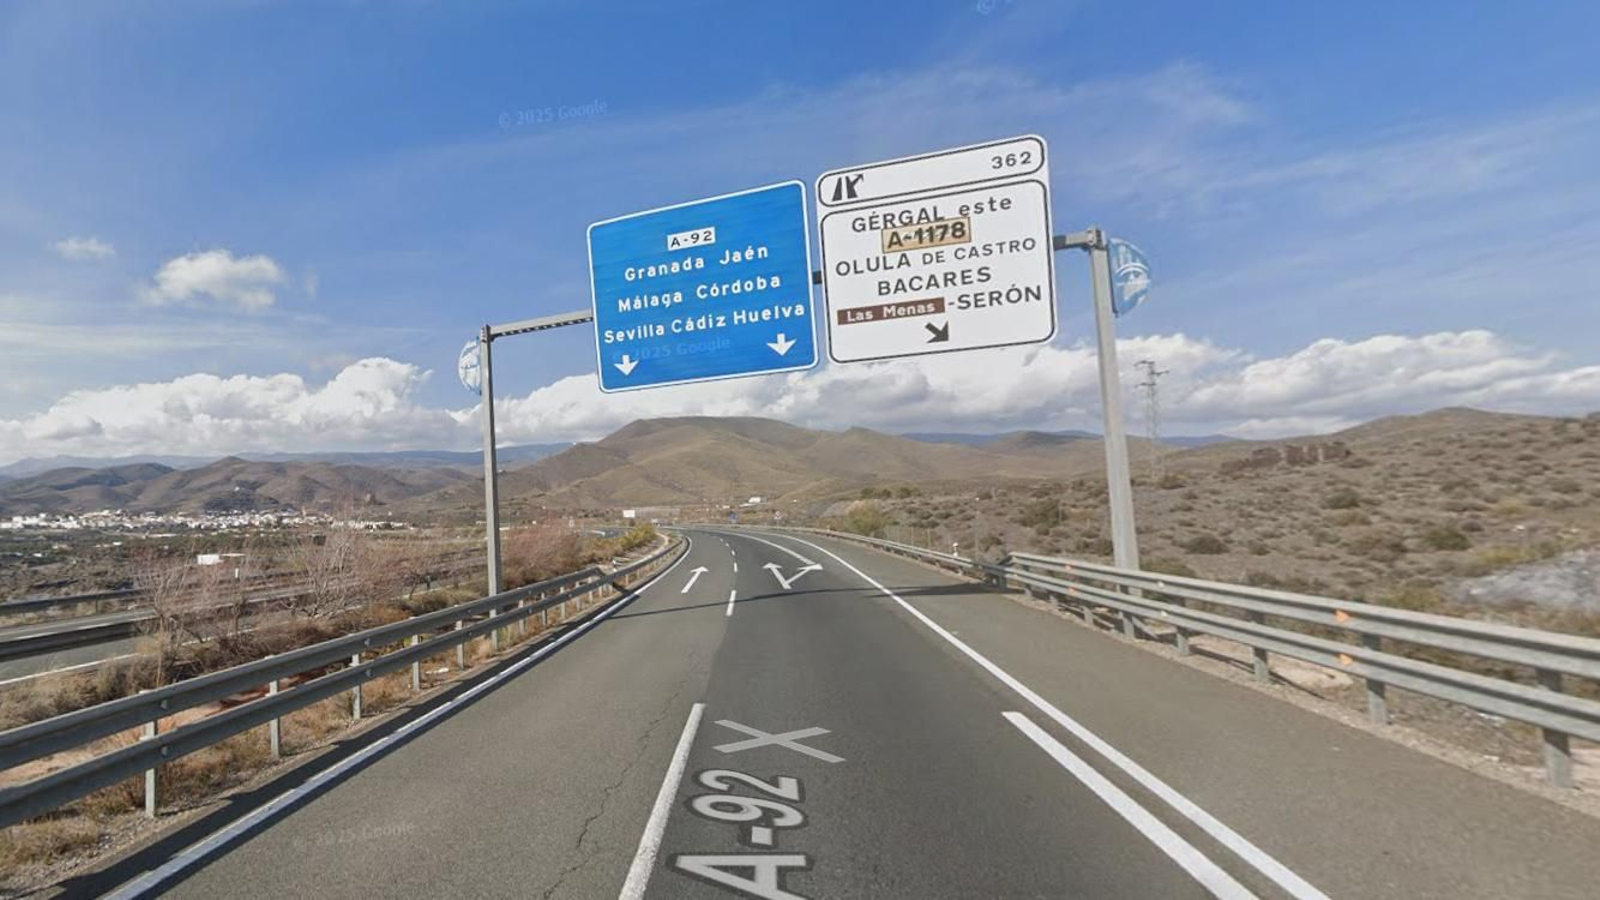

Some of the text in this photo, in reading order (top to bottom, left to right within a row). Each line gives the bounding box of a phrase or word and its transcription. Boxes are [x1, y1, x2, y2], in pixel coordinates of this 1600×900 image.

[991, 151, 1032, 170] 362
[851, 197, 1013, 233] GÉRGAL este
[671, 231, 713, 248] A-92
[887, 221, 967, 249] A-1178
[625, 245, 769, 282] Granada Jaén
[835, 237, 1037, 277] OLULA DE CASTRO
[618, 274, 782, 313] Málaga Córdoba
[878, 266, 992, 296] BACARES
[604, 303, 805, 344] Sevilla Cádiz Huelva
[846, 309, 874, 323] Las
[882, 301, 936, 319] Menas
[675, 769, 807, 900] A-92
